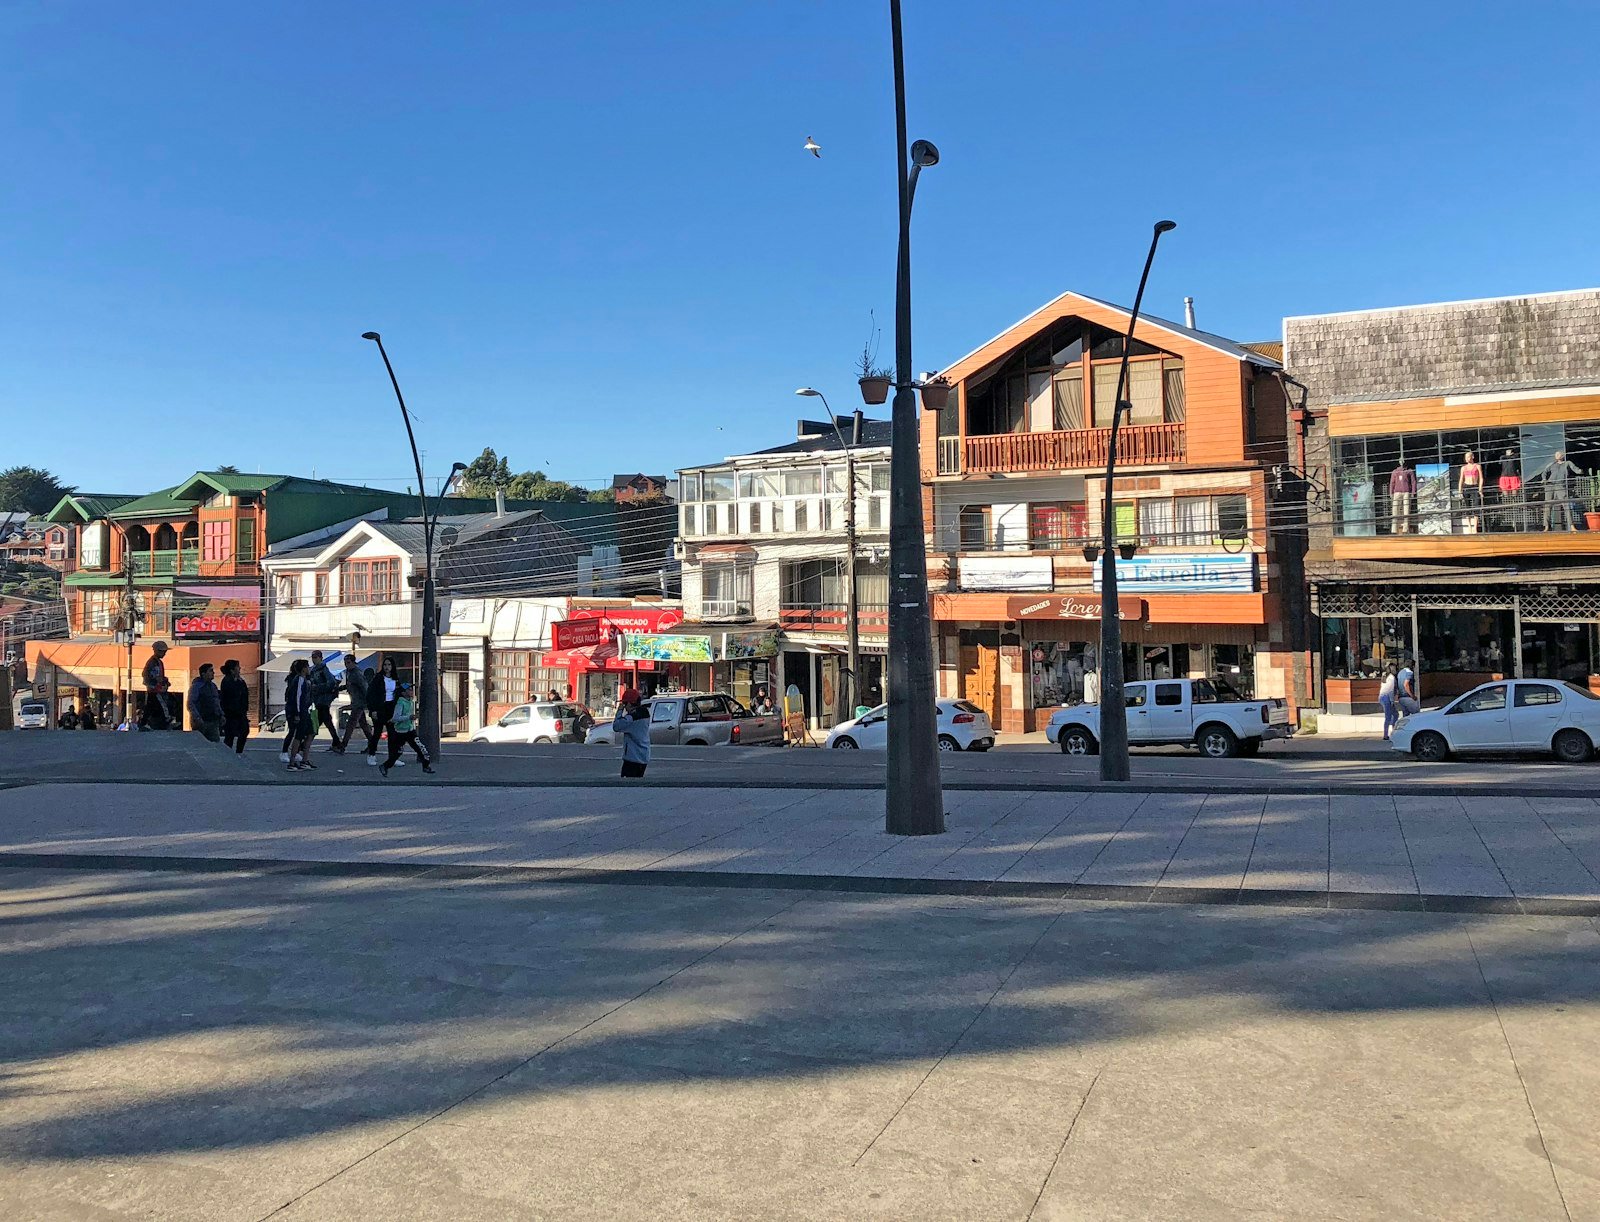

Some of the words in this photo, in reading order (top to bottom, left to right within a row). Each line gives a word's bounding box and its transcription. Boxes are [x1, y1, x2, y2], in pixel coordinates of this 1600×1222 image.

[1134, 565, 1220, 582] Estrella
[1020, 600, 1051, 616] NOVEDADES
[177, 616, 257, 632] CACHICHO
[602, 618, 649, 626] MINIMERCADO
[572, 635, 585, 645] CASA
[585, 633, 599, 643] PAOLA
